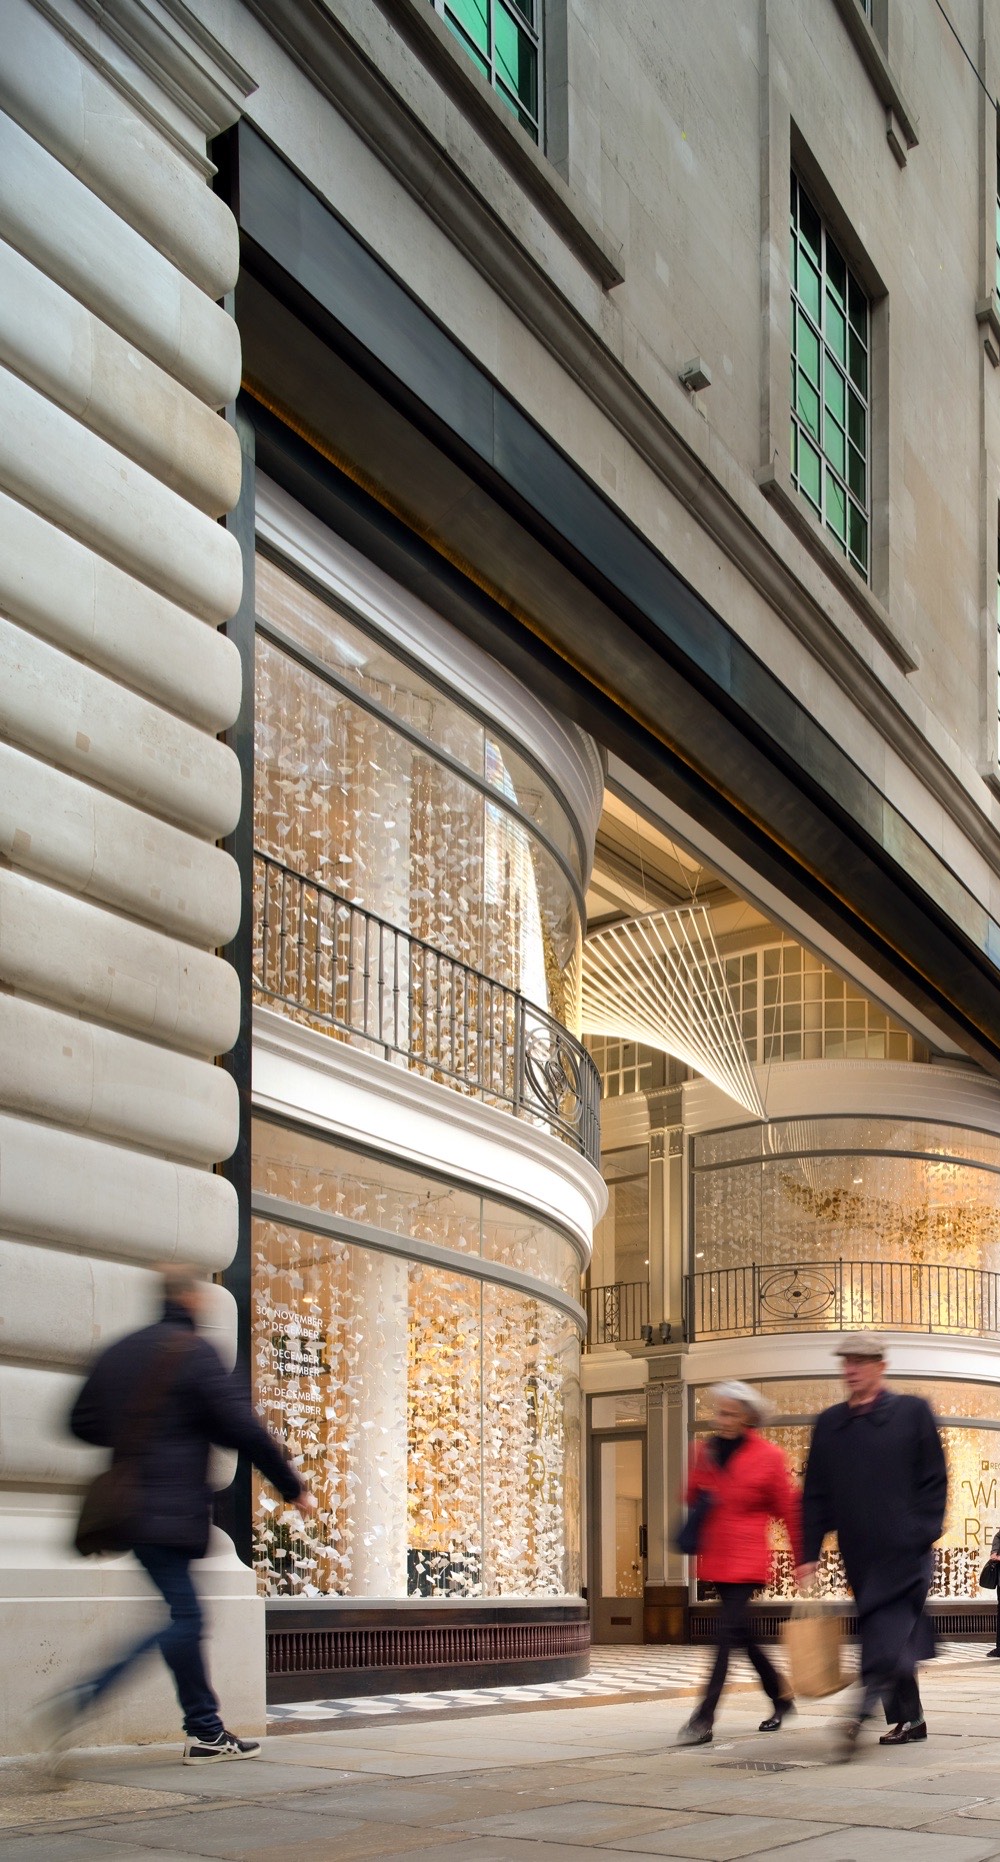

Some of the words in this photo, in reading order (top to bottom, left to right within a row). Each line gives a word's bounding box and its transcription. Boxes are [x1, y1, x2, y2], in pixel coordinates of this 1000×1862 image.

[275, 1310, 323, 1328] NOVEMBER
[272, 1321, 319, 1339] DECEMBER
[272, 1347, 319, 1365] DECEMBER
[272, 1361, 320, 1377] DECEMBER
[274, 1387, 322, 1403] DECEMBER
[274, 1400, 321, 1415] DECEMBER
[296, 1429, 313, 1440] 7PM
